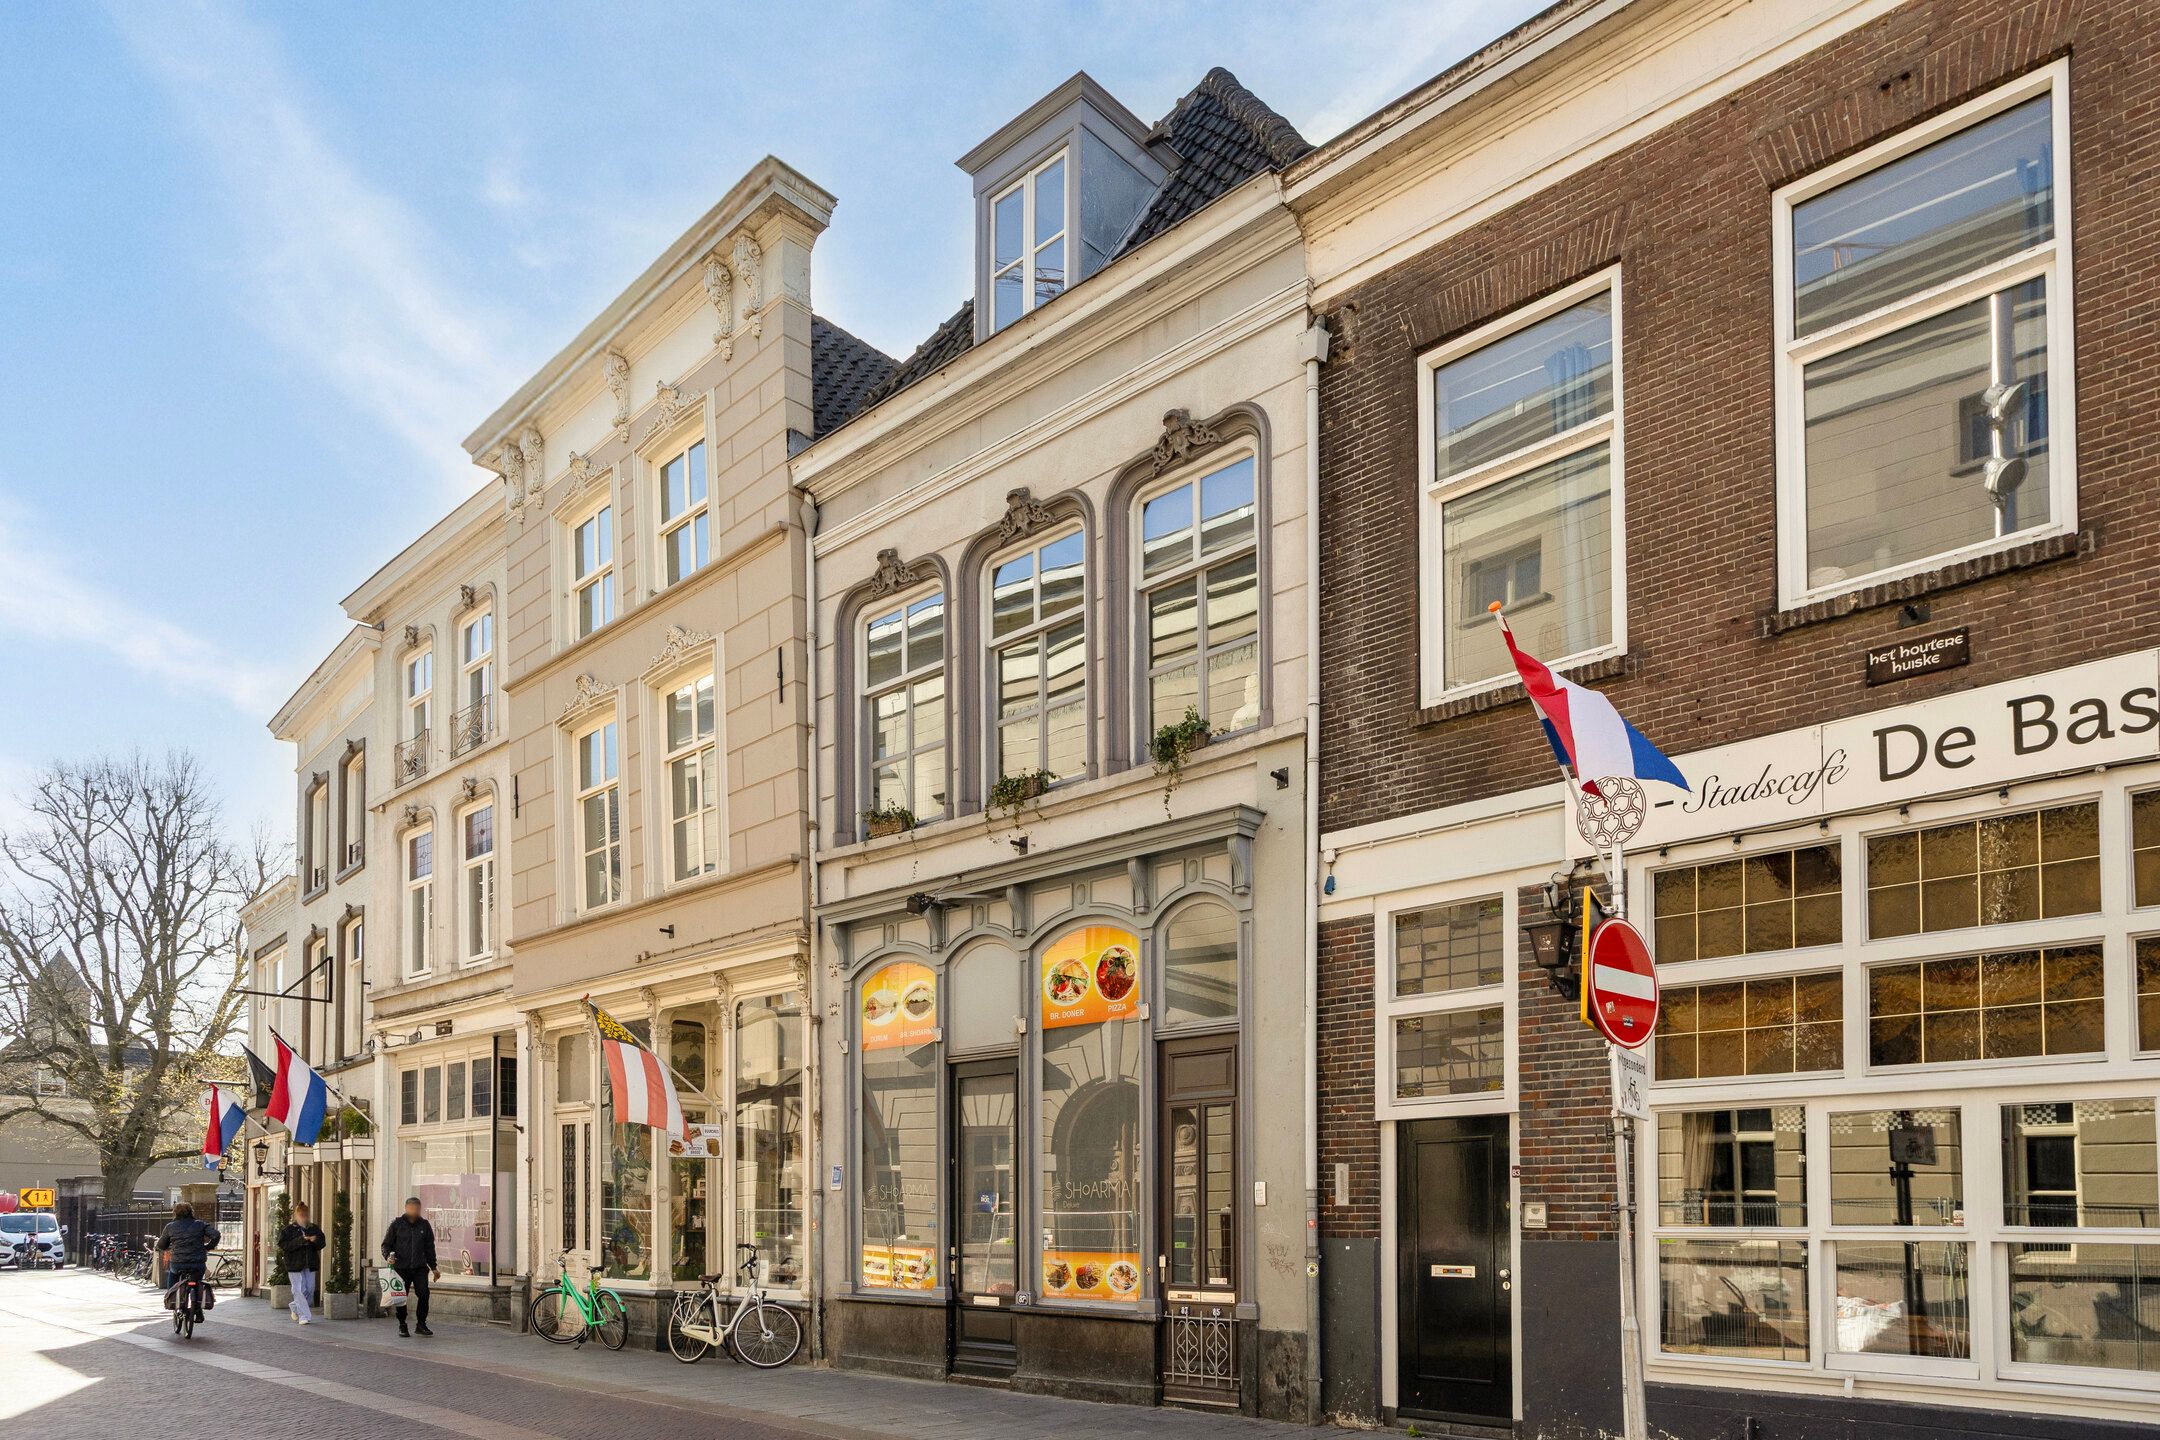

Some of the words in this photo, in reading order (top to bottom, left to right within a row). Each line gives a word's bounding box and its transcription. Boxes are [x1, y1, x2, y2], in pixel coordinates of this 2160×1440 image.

[1682, 748, 1850, 814] Stadscafé
[1872, 723, 1977, 783] De
[1107, 1003, 1127, 1013] PIZZA
[1062, 1008, 1085, 1019] DONER
[35, 1192, 40, 1202] 1
